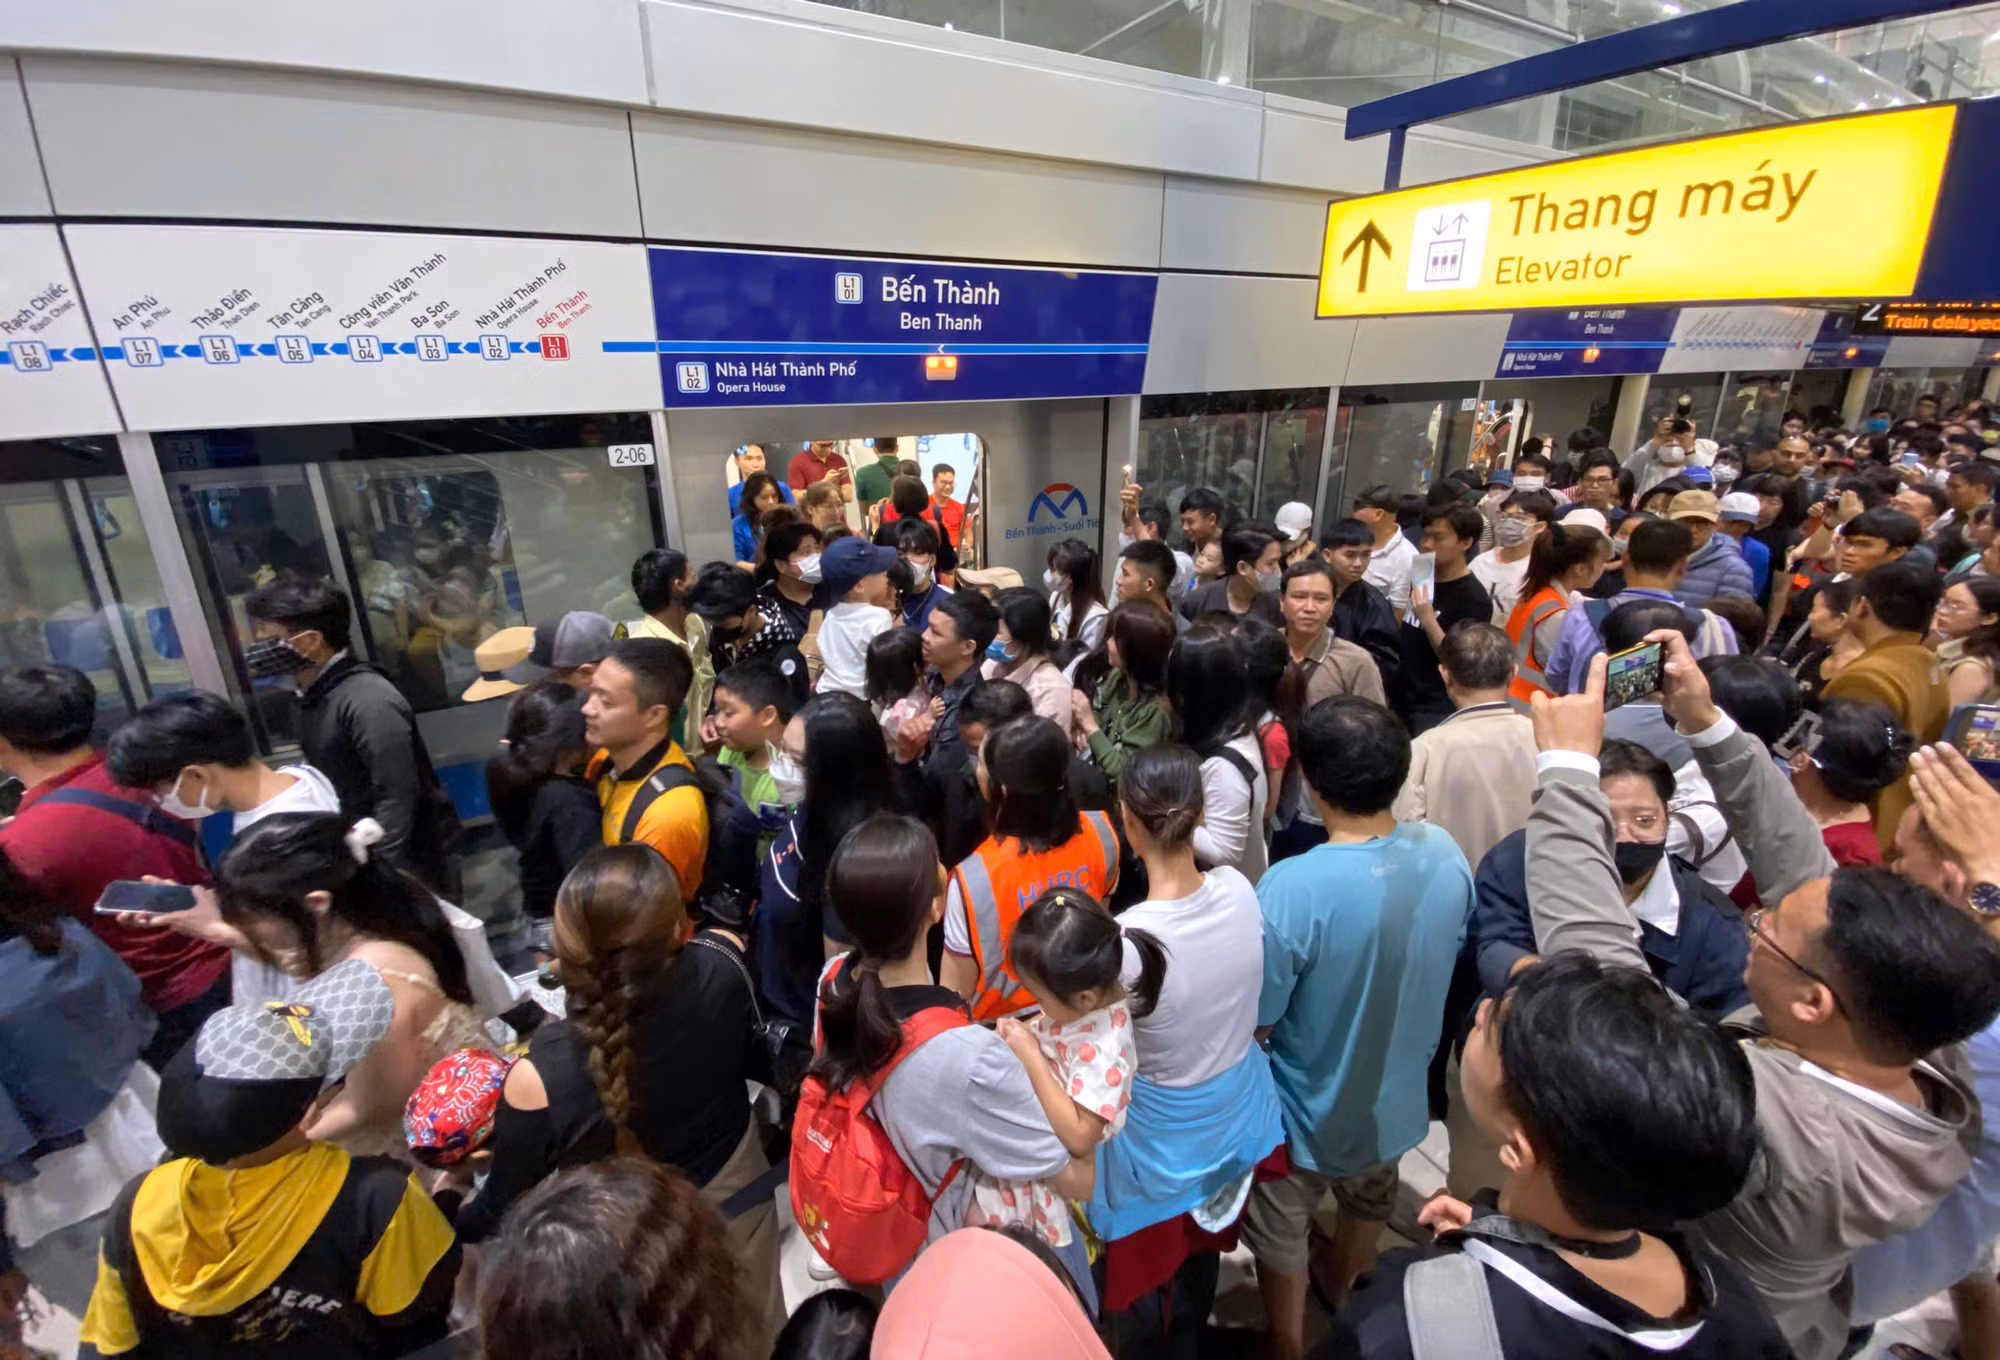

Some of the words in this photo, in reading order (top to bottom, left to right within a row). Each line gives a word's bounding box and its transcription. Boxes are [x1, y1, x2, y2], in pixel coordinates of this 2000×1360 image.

[1508, 188, 1658, 236] Thang
[1678, 159, 1818, 223] máy
[1495, 252, 1632, 286] Elevator
[844, 277, 855, 288] L1
[339, 307, 372, 329] Công
[367, 290, 395, 311] viên
[387, 277, 416, 294] Văn
[409, 253, 447, 279] Thánh
[474, 309, 501, 329] Nhà
[495, 297, 518, 315] Hát
[513, 276, 547, 301] Thành
[543, 257, 566, 280] Phố
[844, 289, 855, 300] 01
[882, 274, 927, 303] Bến
[933, 279, 1000, 305] Thành
[112, 313, 134, 331] An
[128, 294, 159, 317] Phú
[266, 312, 295, 329] Tân
[289, 291, 325, 314] Cảng
[410, 316, 431, 329] Ba
[425, 300, 451, 318] Son
[496, 312, 519, 330] Opera
[515, 298, 540, 316] House
[536, 311, 559, 329] Bến
[555, 290, 588, 314] Thành
[190, 308, 224, 330] Thảo
[433, 319, 448, 330] Ba
[443, 309, 462, 322] Son
[557, 316, 574, 330] Ben
[569, 302, 593, 320] Thanh
[900, 312, 931, 330] Ben
[935, 313, 982, 331] Thanh
[1885, 313, 1928, 329] Train
[132, 340, 150, 352] L1
[210, 338, 227, 350] L1
[285, 338, 301, 349] L1
[355, 338, 373, 349] L1
[423, 337, 438, 349] L1
[487, 337, 501, 348] L1
[547, 337, 561, 348] L1
[19, 344, 37, 356] L1
[212, 350, 231, 361] 06
[287, 350, 305, 361] 05
[358, 349, 375, 360] 04
[425, 348, 441, 359] 03
[489, 348, 504, 359] 02
[549, 347, 562, 358] 01
[23, 357, 42, 369] 08
[135, 353, 153, 364] 07
[686, 366, 700, 377] L1
[715, 362, 748, 377] Nhà
[751, 362, 777, 377] Hát
[780, 362, 825, 377] Thành
[829, 360, 858, 377] Phố
[687, 378, 701, 389] 02
[717, 382, 750, 395] Opera
[753, 382, 786, 393] House
[614, 446, 647, 464] 2-06
[1005, 528, 1025, 540] Bến
